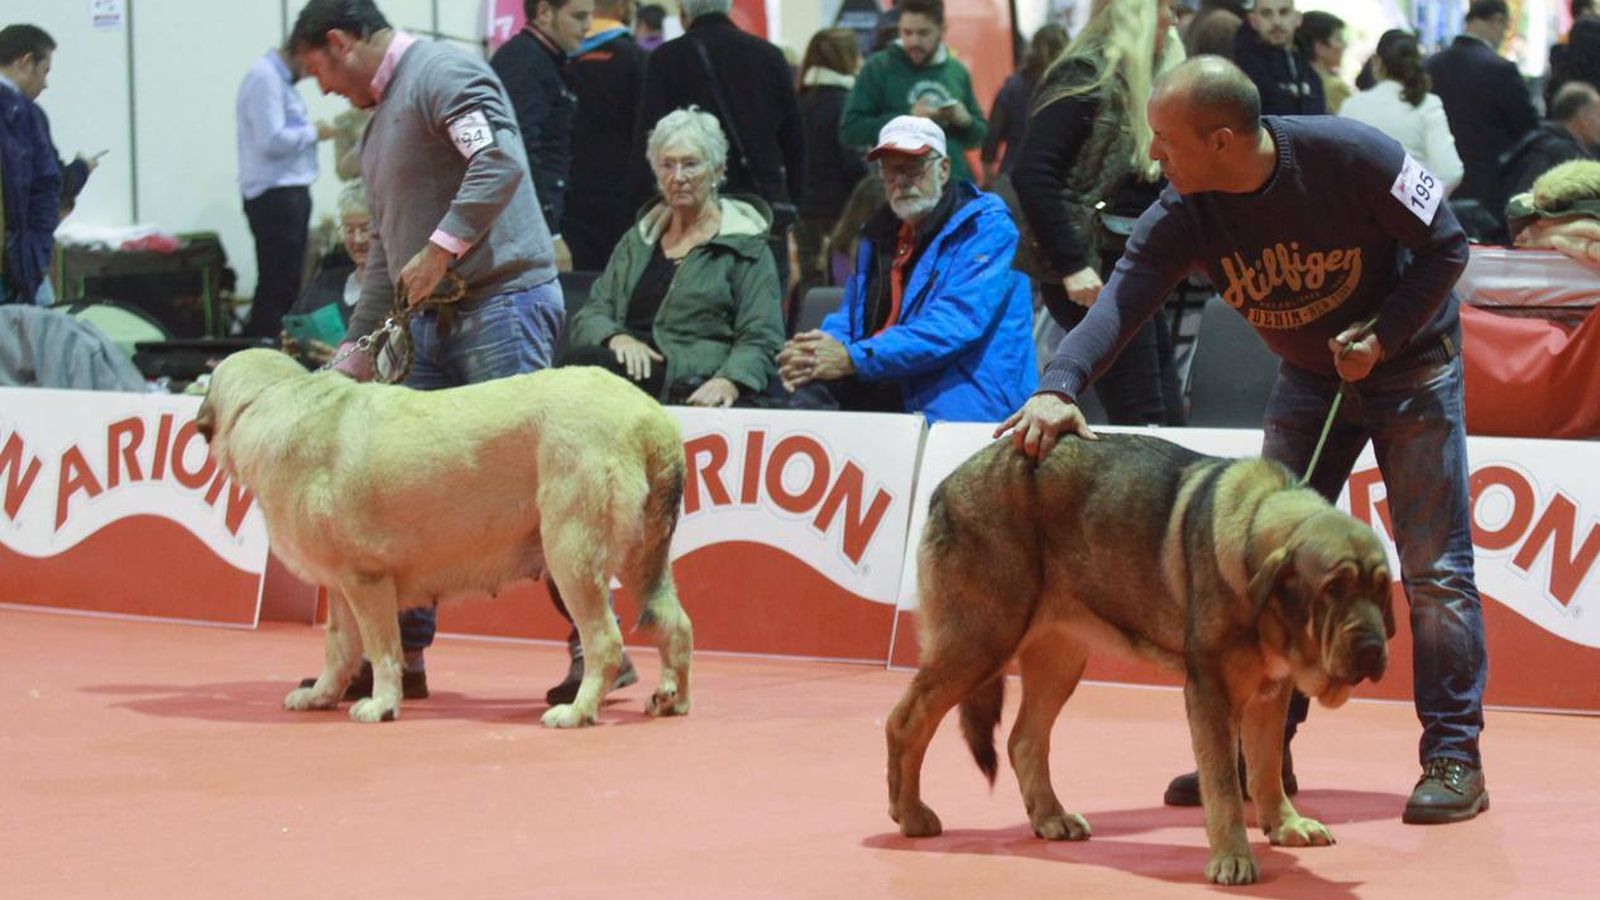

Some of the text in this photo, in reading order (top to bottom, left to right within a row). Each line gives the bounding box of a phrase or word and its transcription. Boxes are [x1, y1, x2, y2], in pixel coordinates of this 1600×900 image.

[1411, 170, 1435, 210] 195
[1221, 242, 1362, 308] Hilfiger
[683, 430, 893, 566] RION
